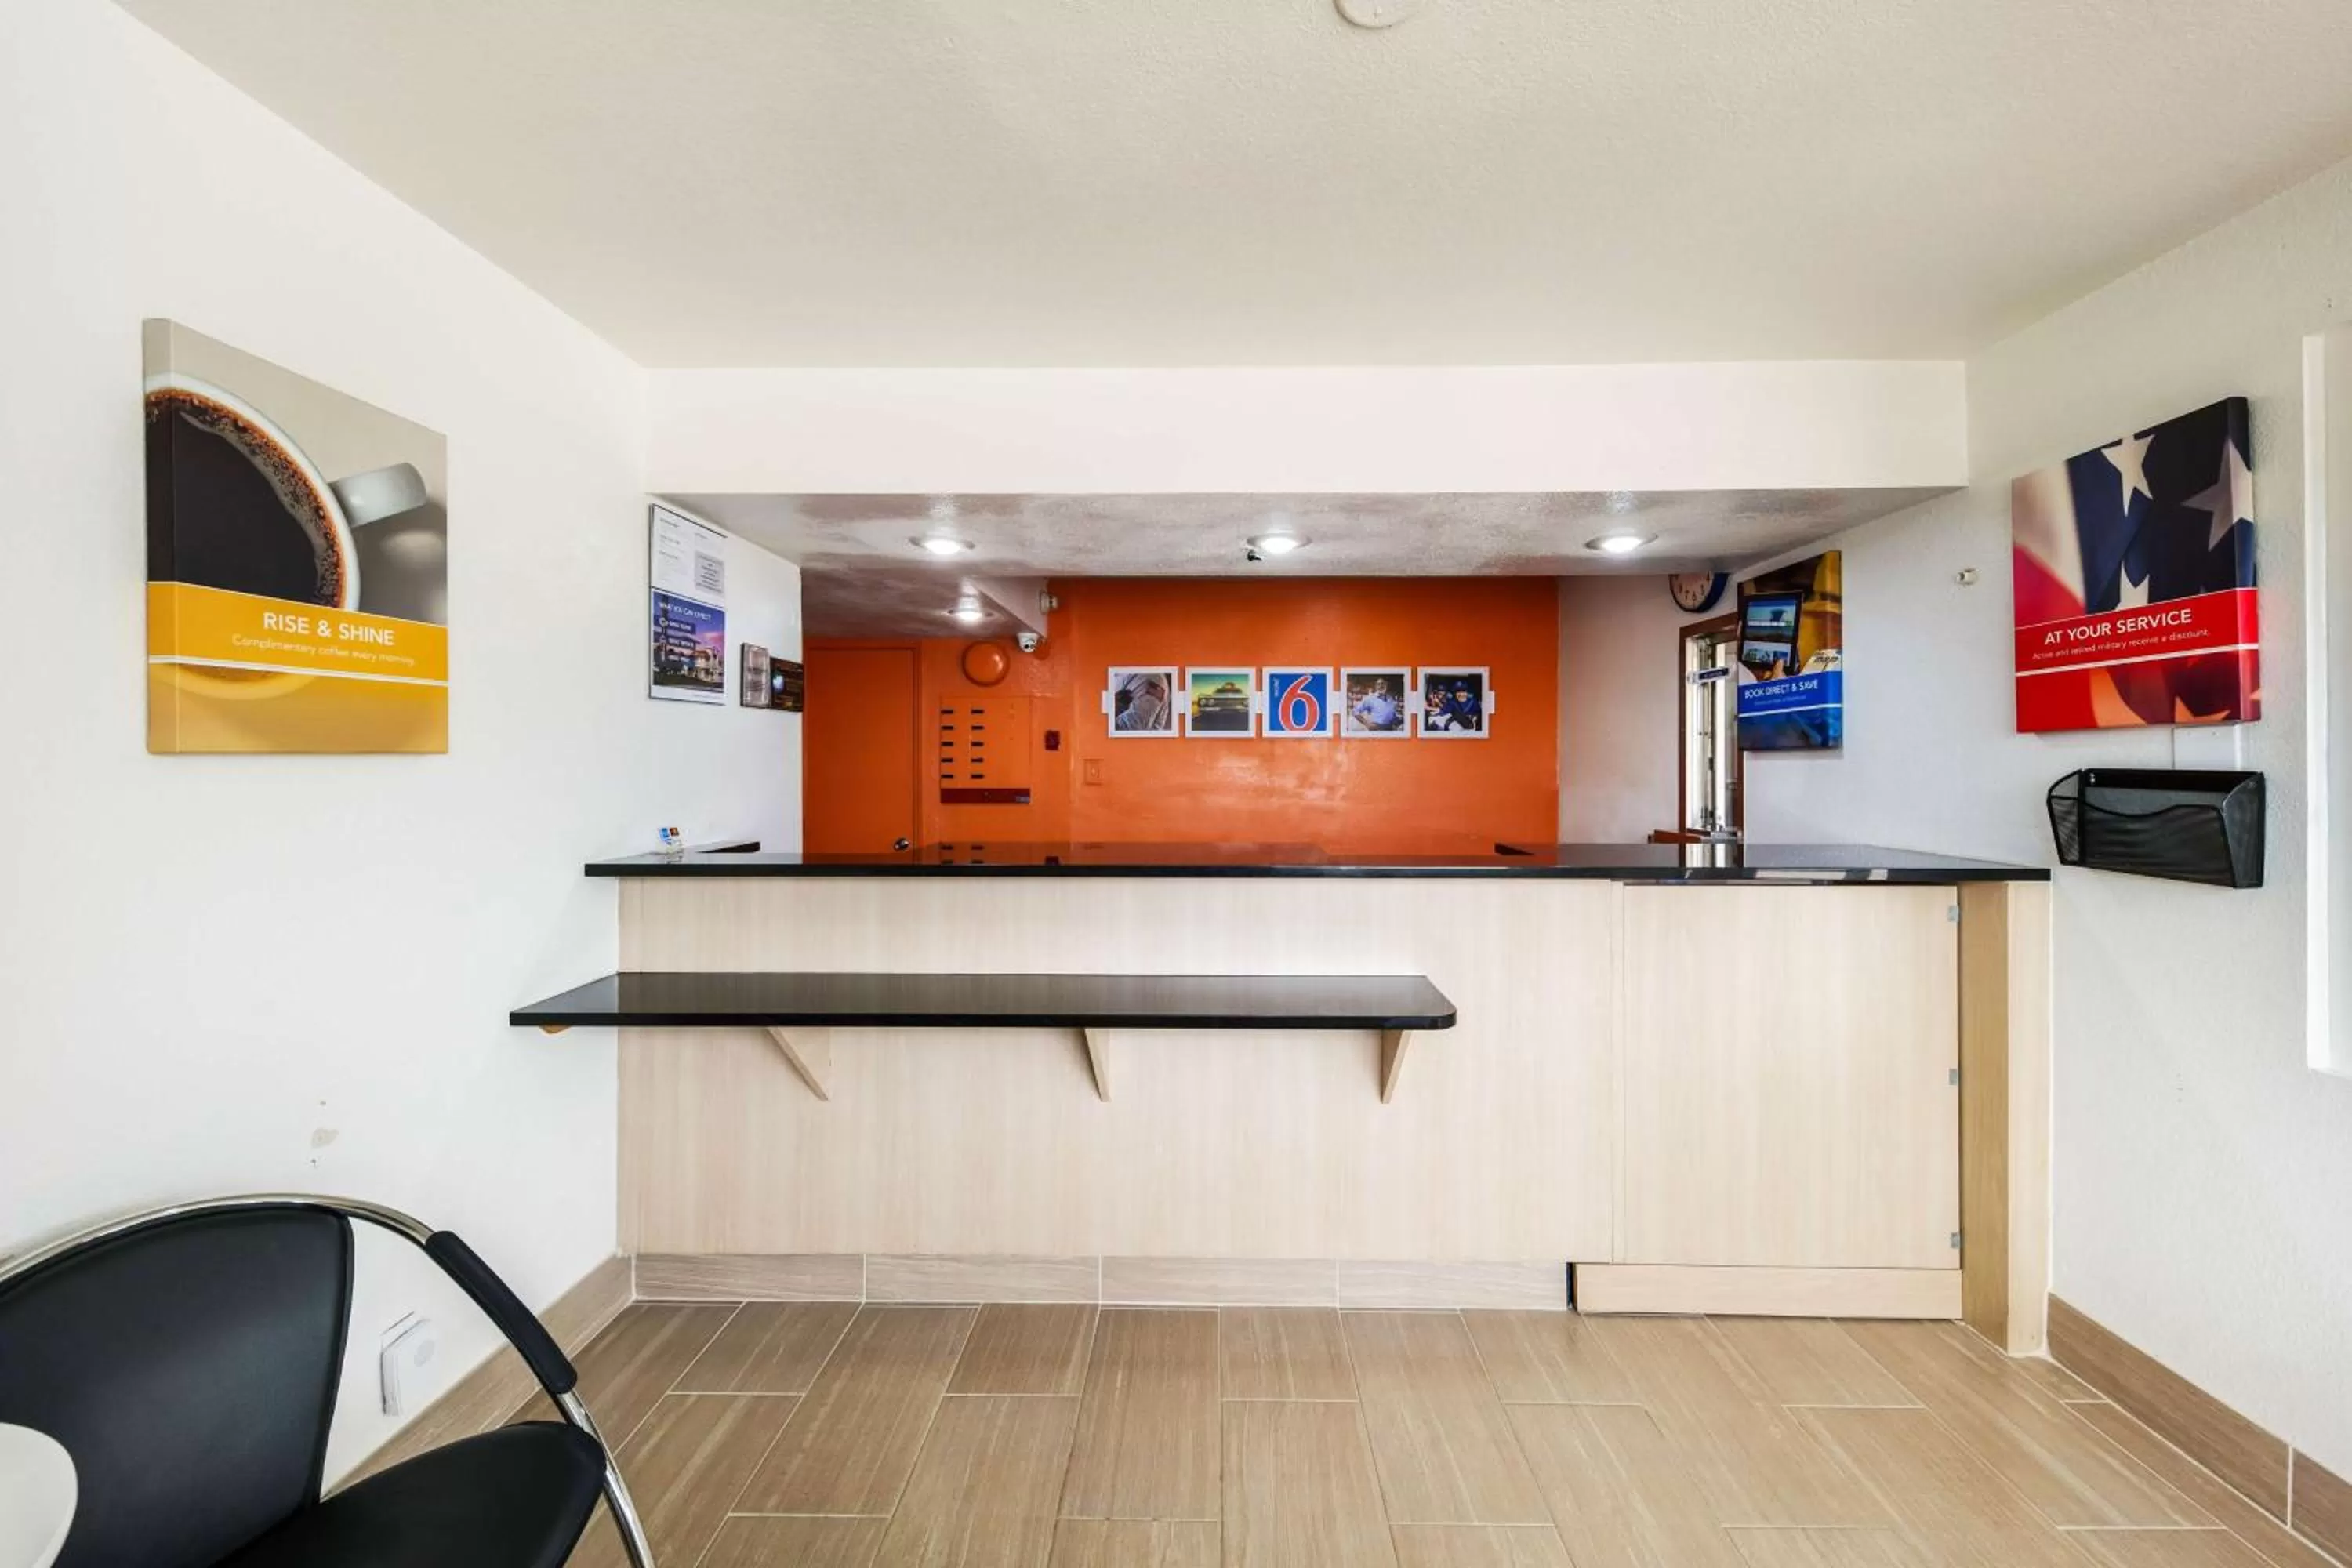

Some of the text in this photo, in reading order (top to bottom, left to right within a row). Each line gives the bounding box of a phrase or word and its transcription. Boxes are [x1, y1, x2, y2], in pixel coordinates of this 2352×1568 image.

[263, 612, 395, 646] RISE & SHINE
[2044, 608, 2192, 645] AT YOUR SERVICE
[1279, 675, 1321, 732] 6
[1744, 688, 1765, 699] BOOK
[1765, 684, 1790, 696] DIRECT
[1799, 678, 1818, 691] SAVE
